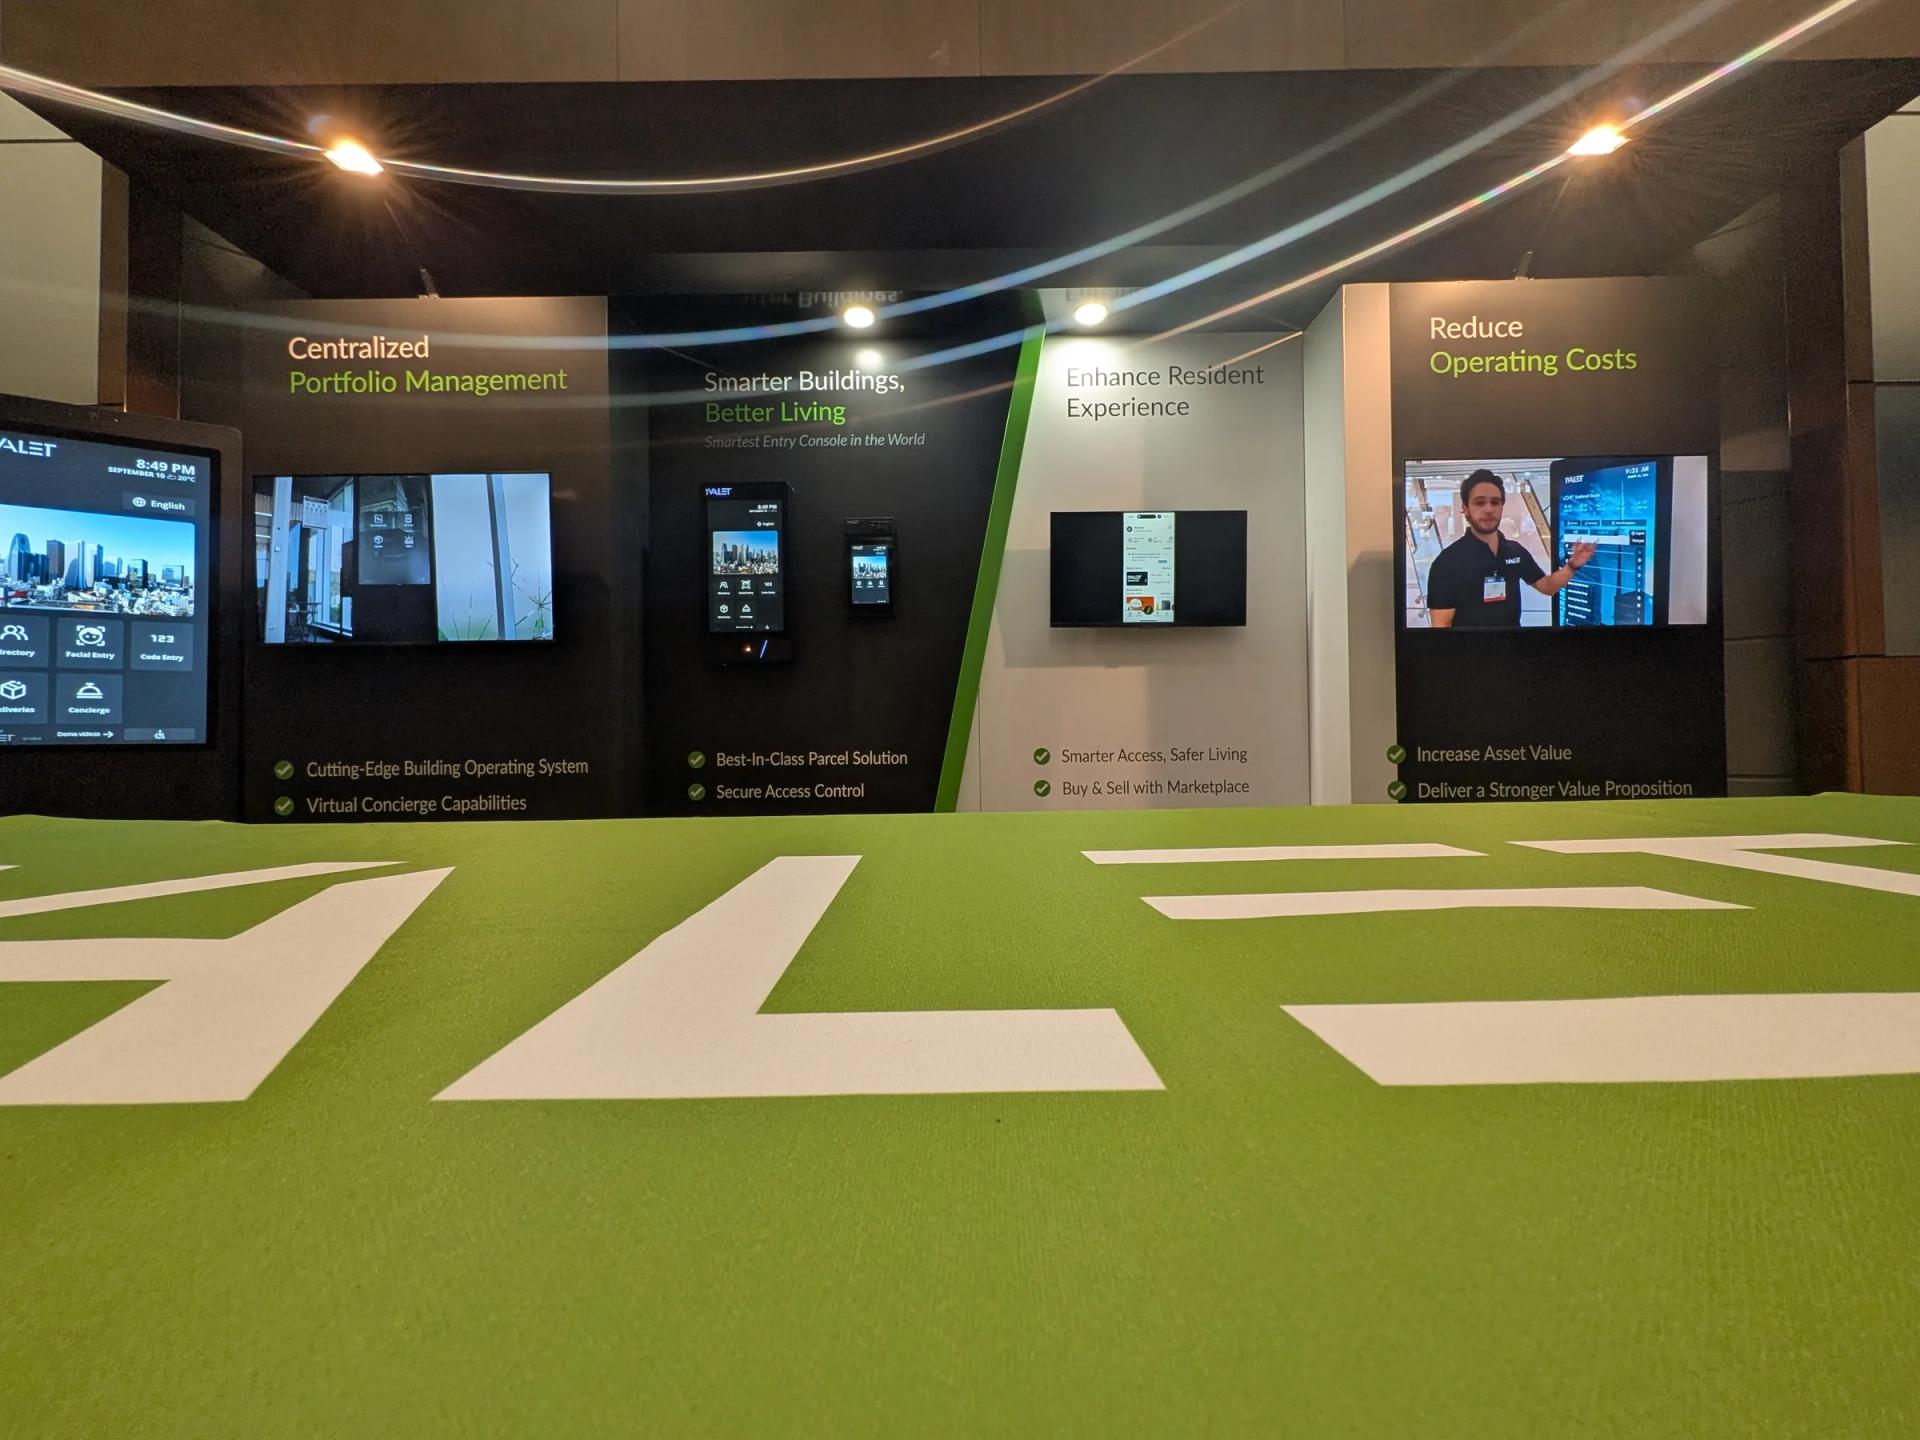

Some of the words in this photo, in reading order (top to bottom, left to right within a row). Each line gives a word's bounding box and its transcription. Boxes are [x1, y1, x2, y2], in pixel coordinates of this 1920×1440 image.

[1430, 315, 1524, 340] Reduce
[288, 335, 430, 360] Centralized
[1429, 349, 1558, 378] Operating
[1566, 347, 1638, 371] Costs
[289, 370, 397, 394] Portfolio
[405, 368, 568, 396] Management
[704, 371, 793, 392] Smarter
[799, 370, 905, 394] Buildings,
[1067, 367, 1161, 387] Enhance
[1168, 364, 1265, 386] Resident
[705, 402, 774, 423] Better
[781, 401, 847, 426] Living
[1067, 397, 1190, 421] Experience
[704, 434, 760, 448] Smartest
[762, 434, 797, 450] Entry
[799, 433, 848, 447] Console
[850, 434, 862, 446] in
[864, 433, 885, 446] the
[887, 433, 926, 446] World
[107, 466, 155, 478] SEPTEMBER
[136, 459, 168, 471] 8:49
[171, 463, 196, 475] PM
[151, 500, 186, 511] English
[150, 634, 175, 643] 123
[65, 651, 91, 659] Facial
[92, 652, 116, 660] Entry
[140, 653, 160, 661] Code
[162, 654, 184, 662] Entry
[68, 706, 111, 715] Concierge
[716, 752, 805, 767] Best-In-Class
[808, 751, 849, 766] Parcel
[852, 750, 908, 766] Solution
[1061, 749, 1114, 763] Smarter
[1117, 748, 1167, 764] Access,
[1170, 747, 1204, 762] Safer
[1208, 746, 1248, 763] Living
[1417, 745, 1480, 762] Increase
[1483, 745, 1526, 761] Asset
[1529, 744, 1572, 761] Value
[306, 760, 400, 780] Cutting-Edge
[404, 759, 461, 778] Building
[464, 759, 535, 778] Operating
[538, 757, 589, 777] System
[716, 784, 762, 799] Secure
[765, 784, 811, 798] Access
[814, 783, 865, 798] Control
[1062, 781, 1088, 798] Buy
[1091, 781, 1102, 795] &
[1106, 780, 1130, 795] Sell
[1133, 780, 1163, 794] with
[1167, 779, 1250, 796] Marketplace
[1418, 782, 1472, 799] Deliver
[1476, 786, 1485, 798] a
[1489, 781, 1555, 800] Stronger
[1558, 780, 1601, 797] Value
[1604, 779, 1693, 798] Proposition
[306, 796, 358, 813] Virtual
[361, 796, 437, 815] Concierge
[441, 794, 528, 814] Capabilities
